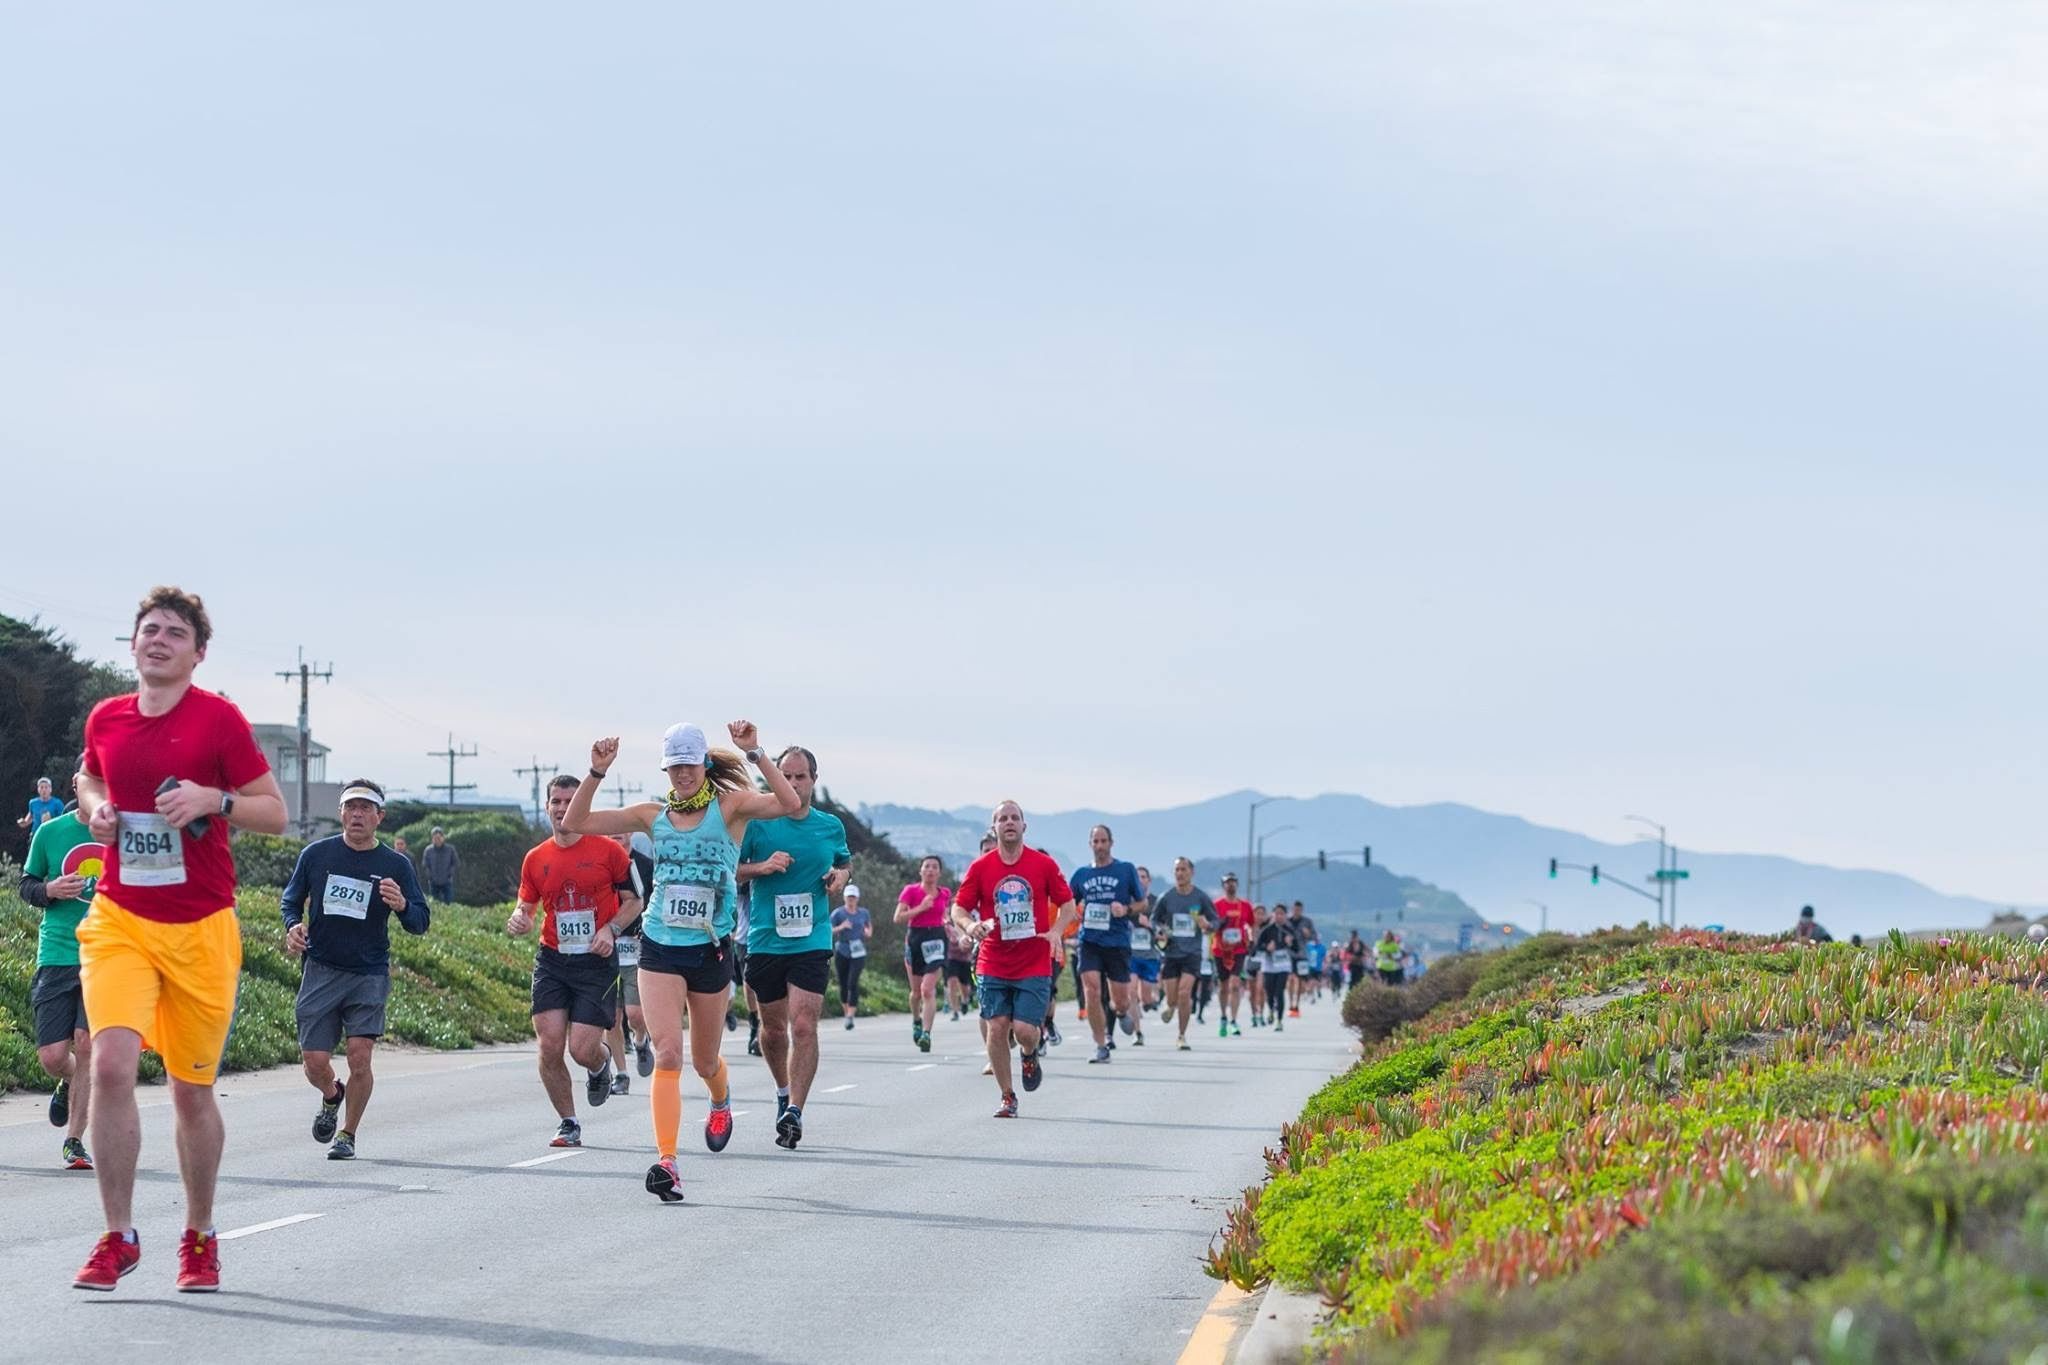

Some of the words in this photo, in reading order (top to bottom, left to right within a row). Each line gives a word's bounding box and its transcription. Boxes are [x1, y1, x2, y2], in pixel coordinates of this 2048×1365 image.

[124, 830, 173, 855] 2664
[330, 885, 365, 903] 2879
[670, 899, 708, 918] 1694
[780, 904, 809, 919] 3412
[1004, 911, 1030, 924] 1782
[560, 922, 590, 936] 3413
